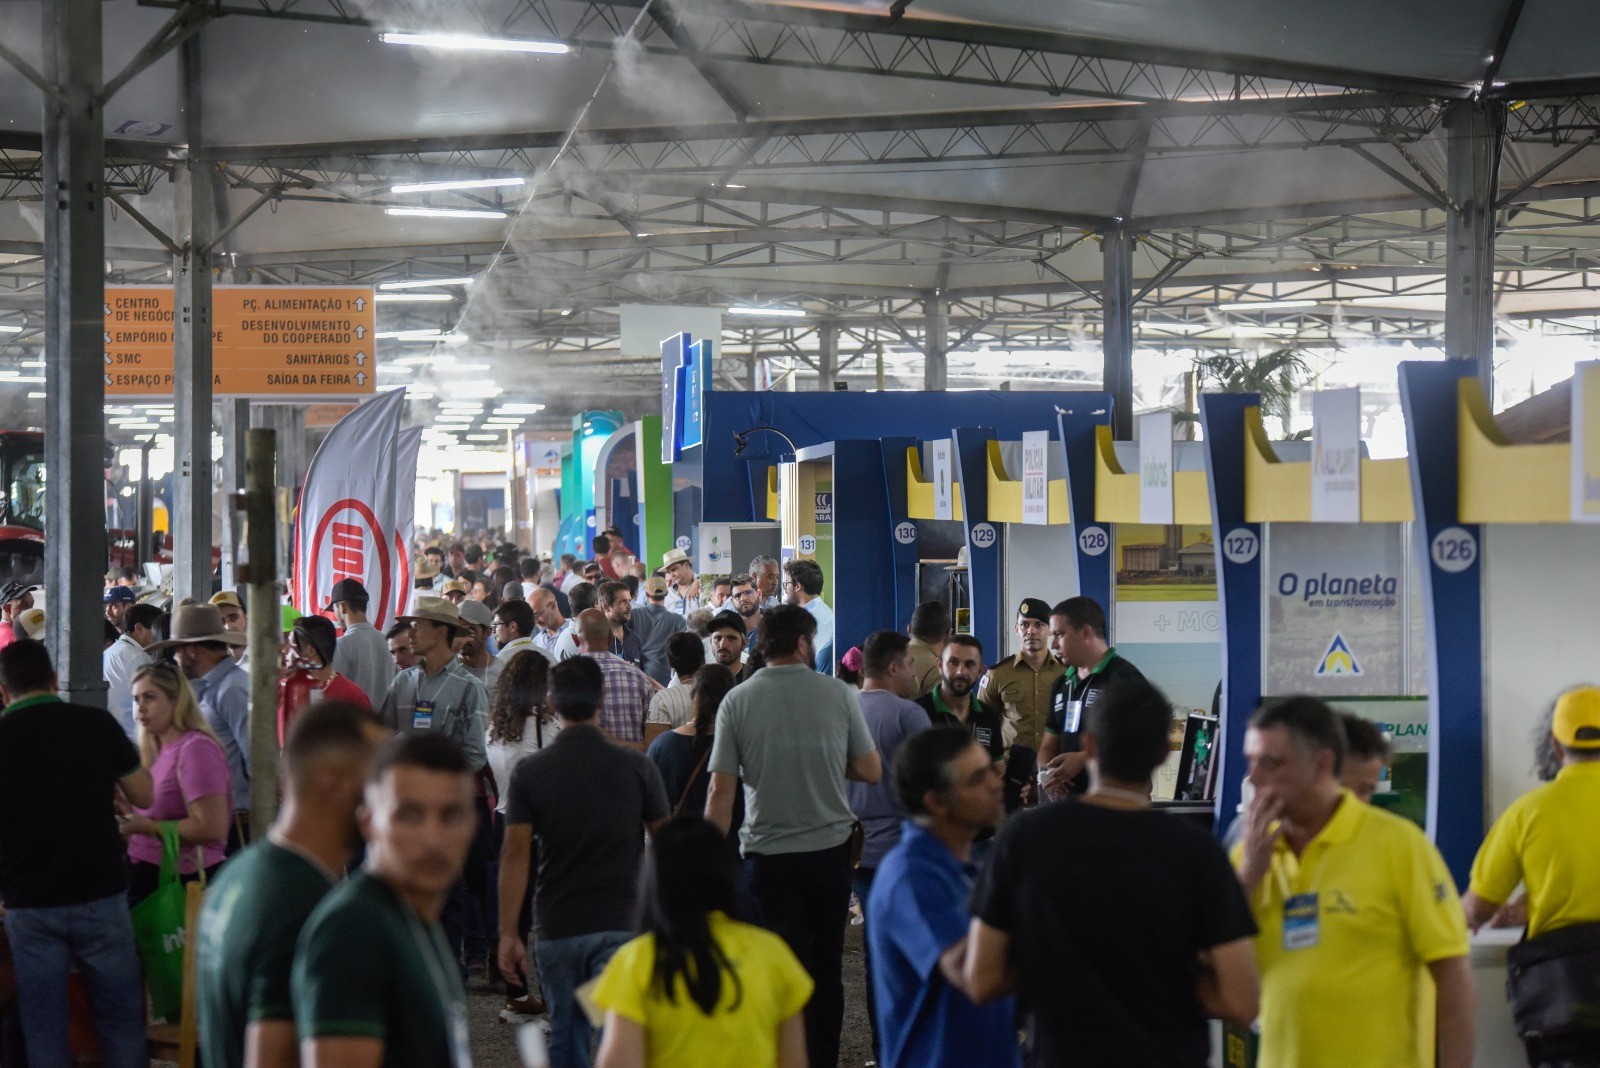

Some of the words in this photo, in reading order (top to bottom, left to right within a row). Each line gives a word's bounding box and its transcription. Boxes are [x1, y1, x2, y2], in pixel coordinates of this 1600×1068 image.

[116, 298, 159, 309] CENTRO
[242, 299, 261, 312] PÇ.
[264, 297, 342, 312] ALIMENTAÇÃO
[346, 299, 351, 310] 1
[116, 311, 130, 321] DE
[242, 320, 351, 331] DESENVOLVIMENTO
[116, 330, 167, 342] EMPÓRIO
[263, 333, 278, 343] DO
[282, 333, 351, 343] COOPERADO
[117, 353, 141, 364] SMC
[286, 352, 350, 365] SANITÁRIOS
[116, 374, 160, 388] ESPAÇO
[267, 371, 299, 385] SAÍDA
[302, 374, 317, 385] DA
[320, 374, 351, 385] FEIRA
[898, 527, 916, 539] 130
[974, 529, 994, 541] 129
[678, 539, 691, 548] 134
[801, 539, 815, 550] 131
[1081, 533, 1106, 549] 128
[1227, 537, 1254, 554] 127
[1437, 539, 1472, 560] 126
[1278, 572, 1298, 596] O
[1304, 571, 1397, 601] planeta
[1309, 599, 1324, 607] em
[1326, 597, 1397, 609] transformação
